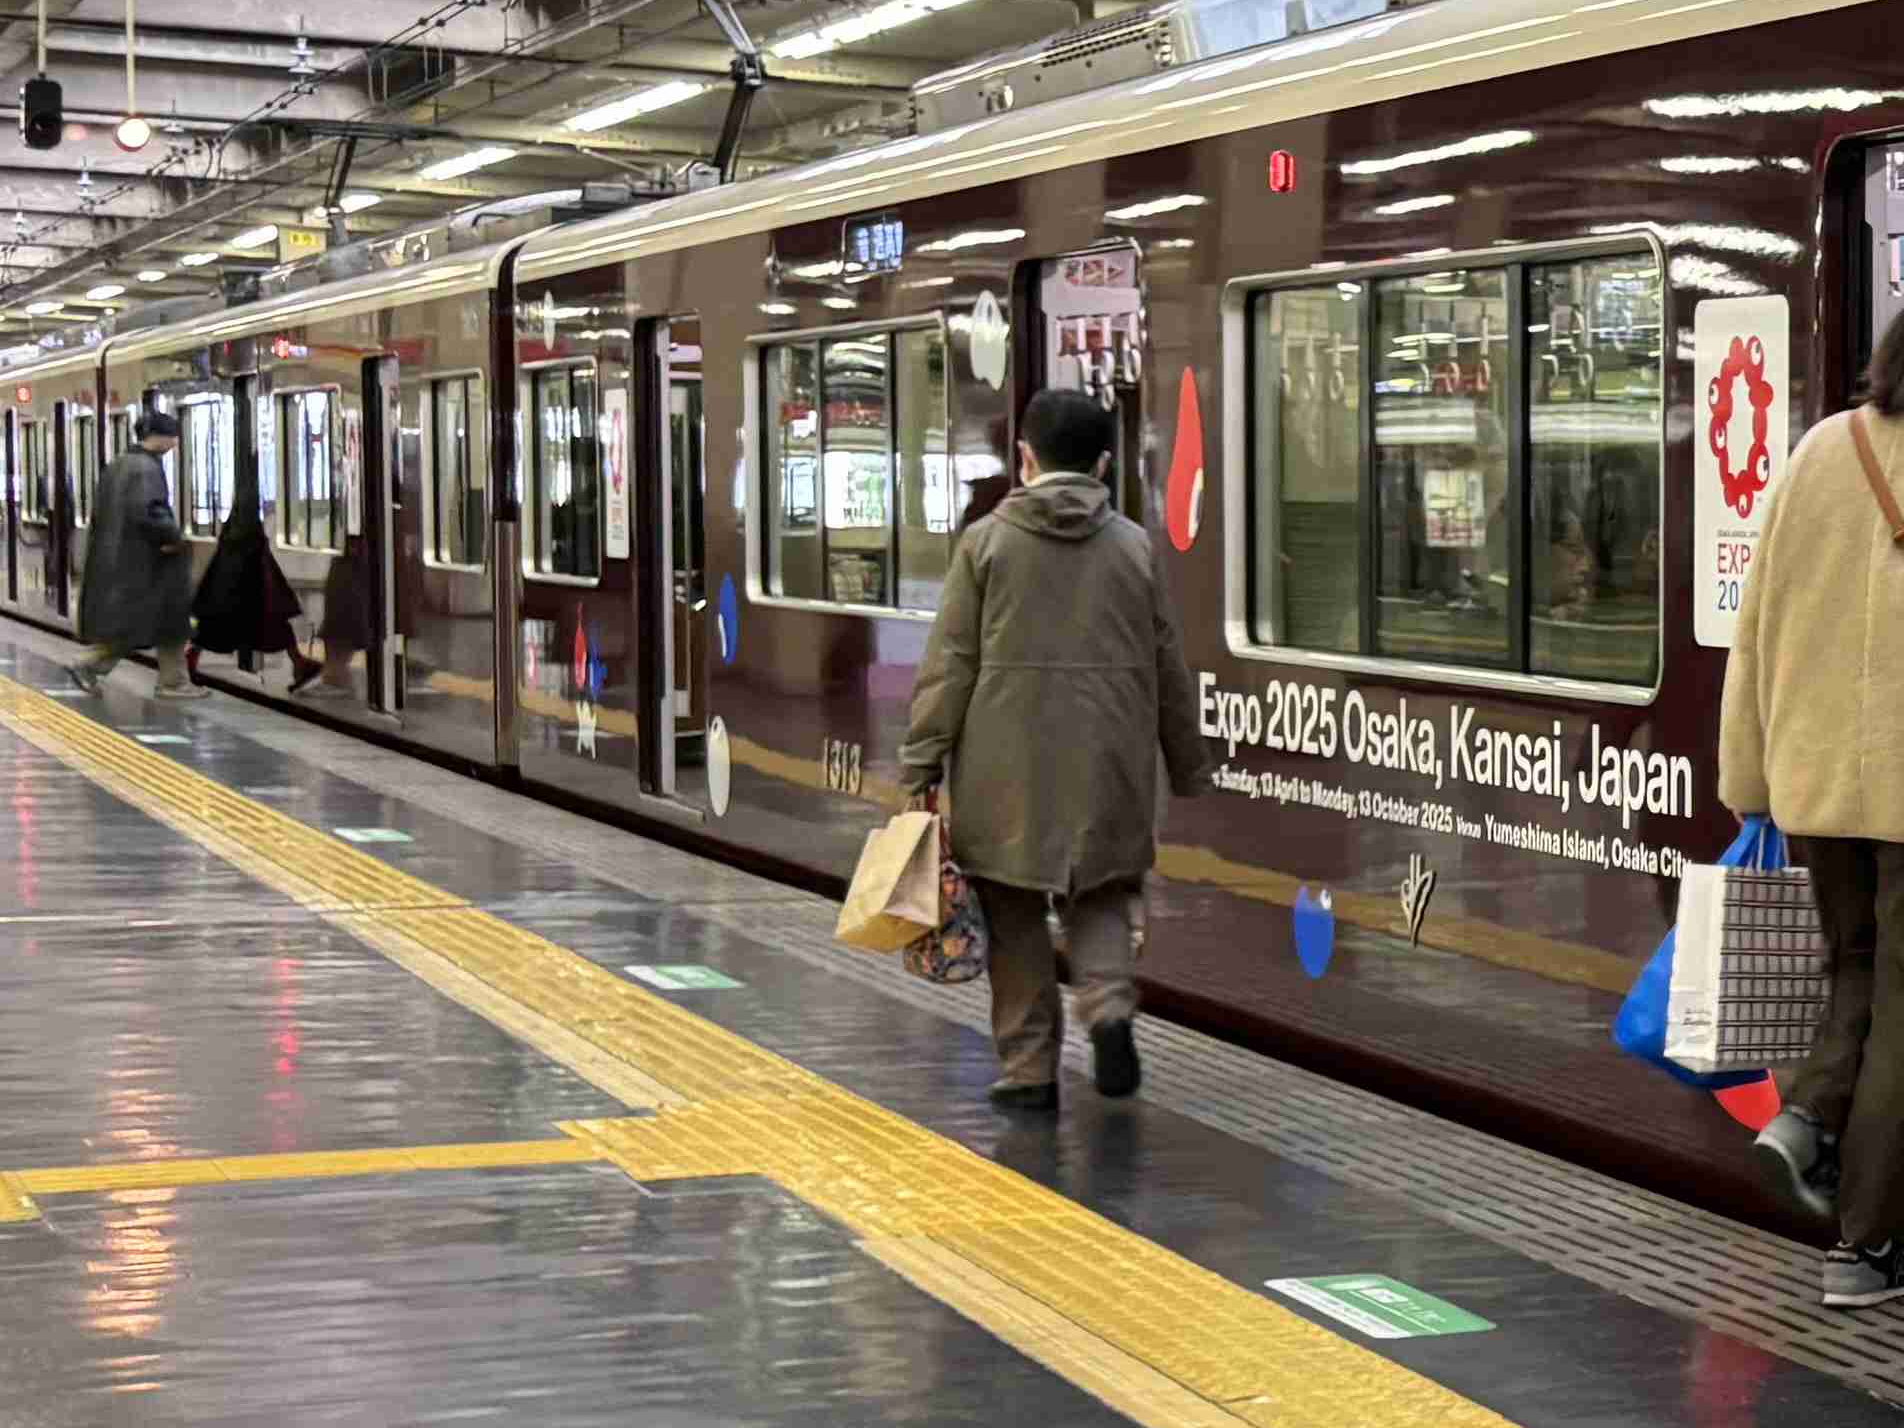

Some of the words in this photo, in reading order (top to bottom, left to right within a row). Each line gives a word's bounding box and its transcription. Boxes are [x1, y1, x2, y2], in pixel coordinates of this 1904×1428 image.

[1717, 542, 1751, 575] EXP
[1717, 579, 1741, 612] 20
[1199, 671, 1263, 758] Expo
[1266, 679, 1338, 759] 2025
[1343, 689, 1443, 790] Osaka,
[1451, 705, 1570, 814] Kansai,
[1578, 723, 1693, 830] Japan
[1358, 790, 1371, 817] 13
[1372, 791, 1420, 826] October
[1421, 801, 1453, 833] 2025
[1484, 812, 1561, 855] Yumeshima
[1562, 827, 1610, 870] Island,
[1611, 837, 1658, 875] Osaka
